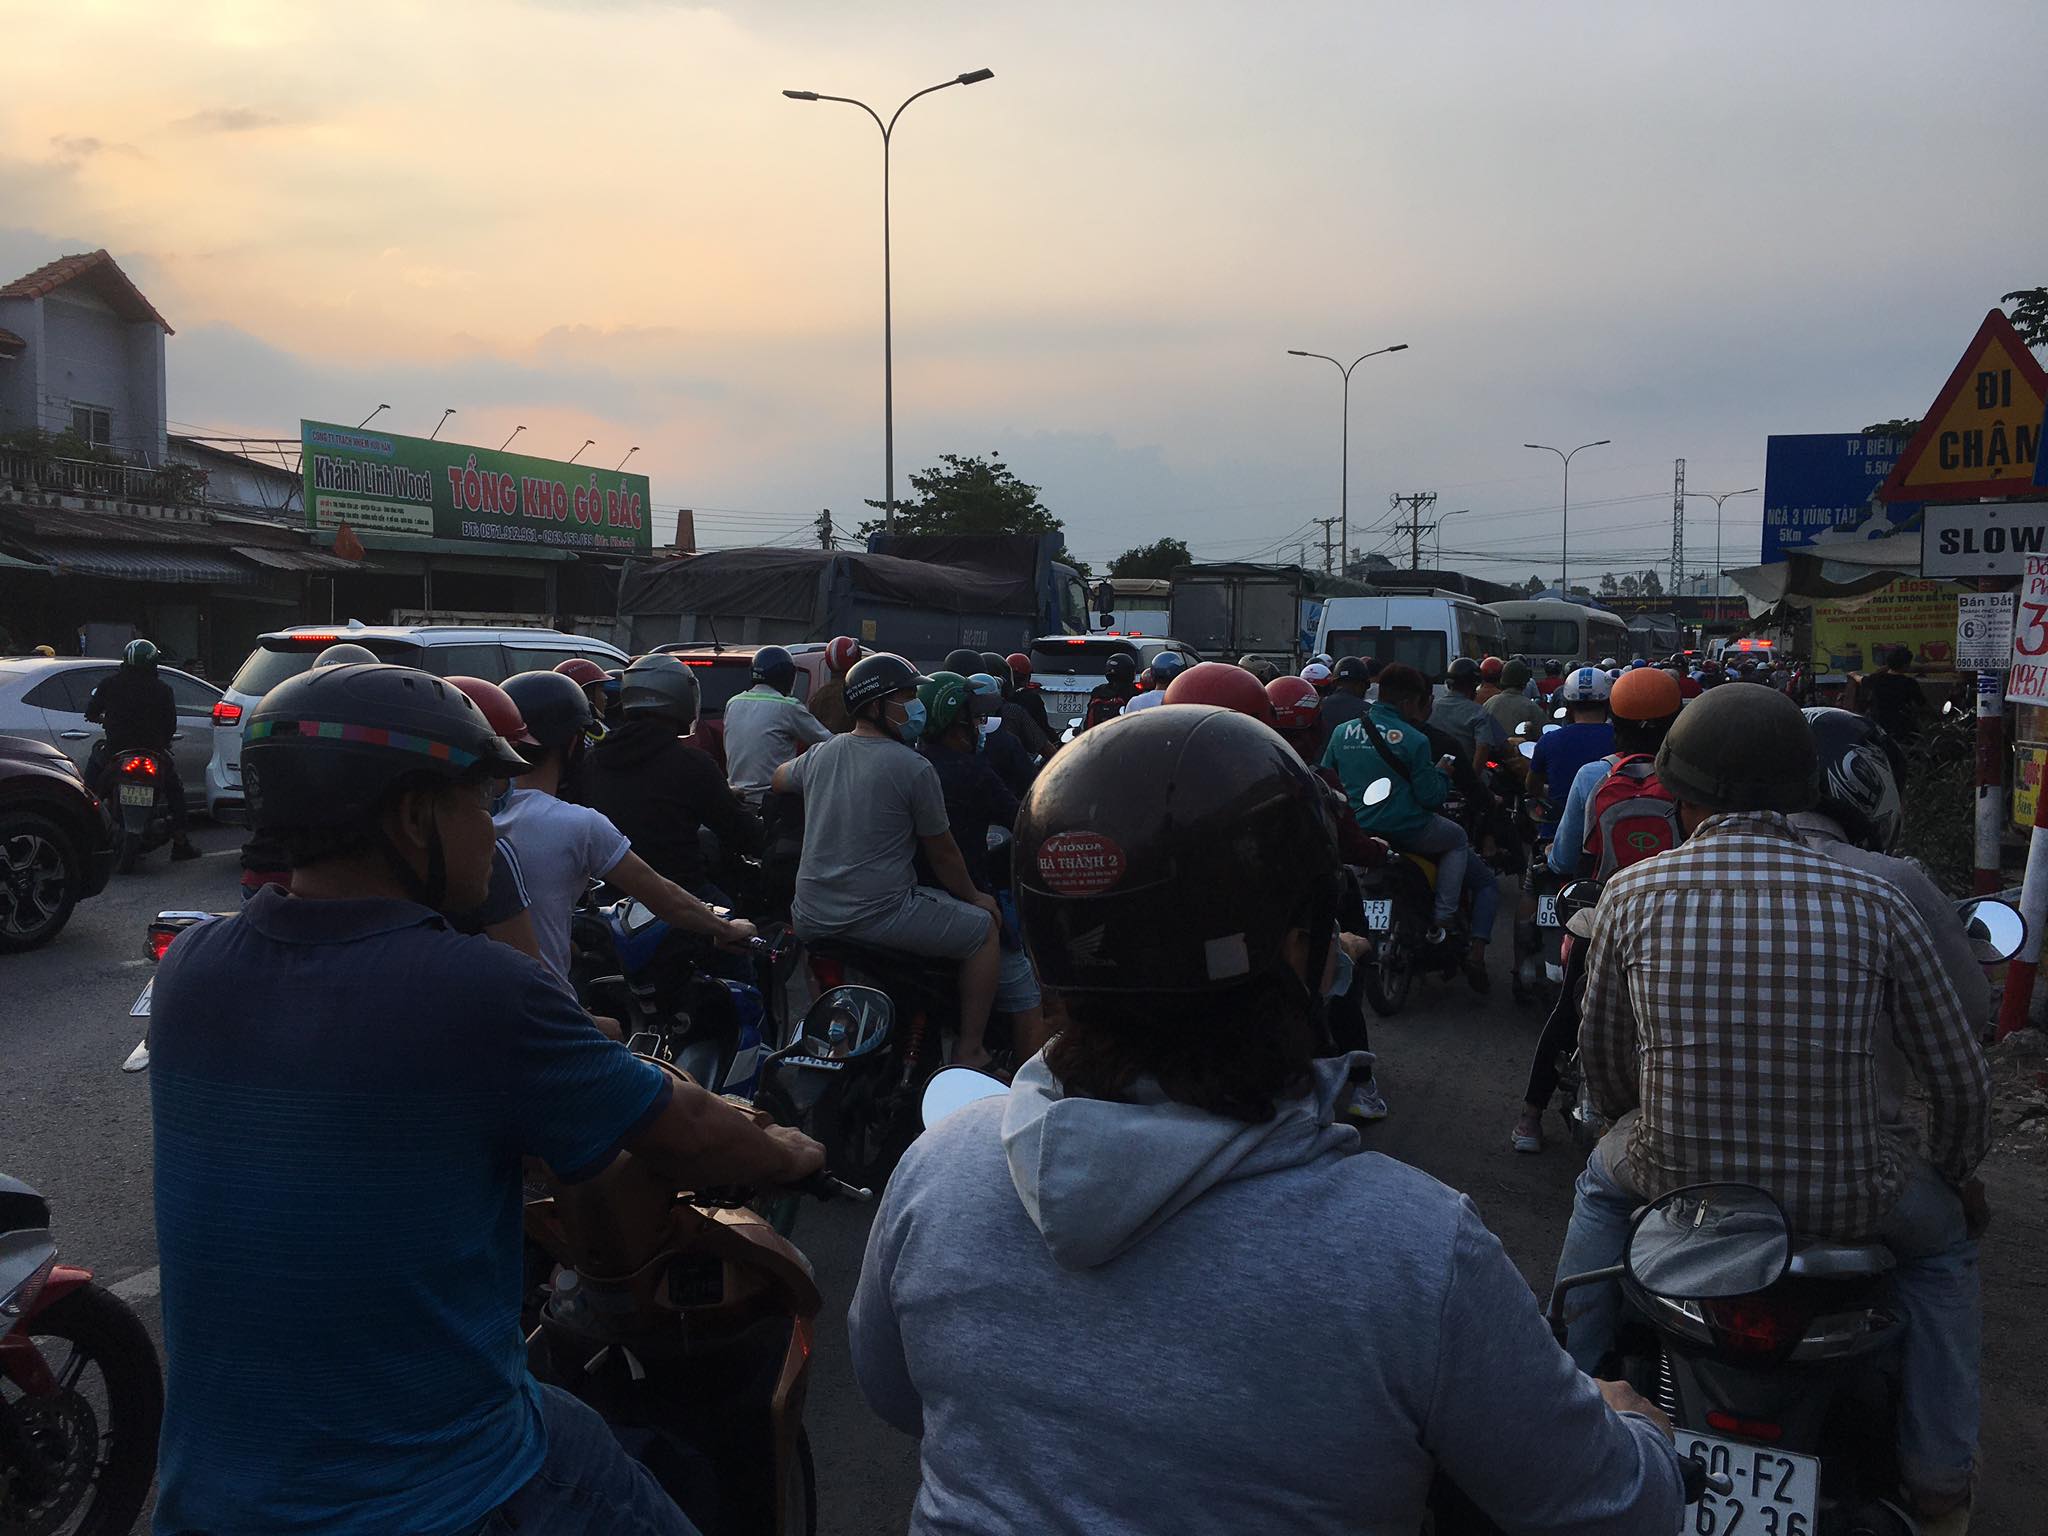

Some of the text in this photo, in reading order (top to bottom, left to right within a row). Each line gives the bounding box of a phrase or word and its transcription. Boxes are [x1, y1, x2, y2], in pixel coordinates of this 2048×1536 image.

[1976, 369, 2011, 409] ĐI
[1847, 439, 1863, 456] TP.
[315, 455, 361, 493] Khánh
[394, 466, 432, 501] Wood
[448, 453, 641, 529] TỔNG KHO GỖ BẮC
[1767, 506, 1789, 525] NGÃ
[1792, 508, 1801, 525] 3
[1803, 505, 1832, 525] VŨNG
[1779, 529, 1802, 542] 5Km
[1940, 526, 2045, 556] SLOW
[1960, 594, 2012, 607] Bán Đất
[1964, 621, 1974, 638] 6
[1108, 855, 1119, 867] 2
[1689, 1440, 1797, 1504] 60-F2
